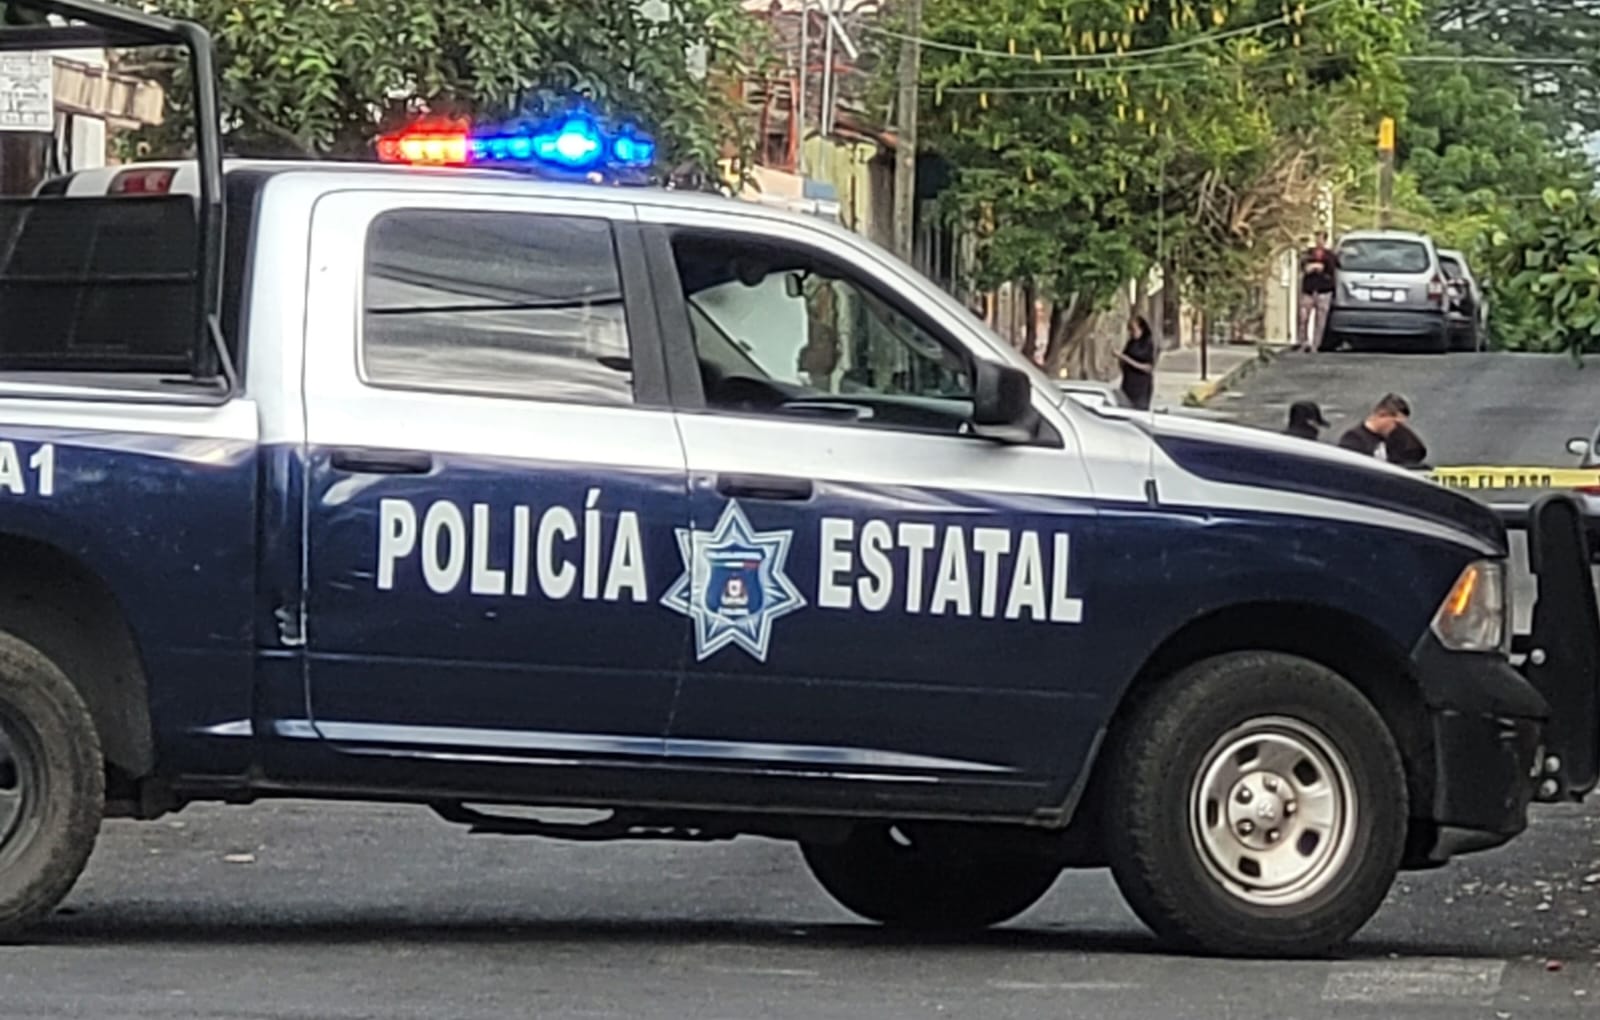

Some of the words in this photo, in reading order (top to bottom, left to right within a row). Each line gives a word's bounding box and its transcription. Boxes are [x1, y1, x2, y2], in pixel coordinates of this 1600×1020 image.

[0, 440, 54, 496] A1
[377, 487, 648, 602] POLICÍA
[817, 517, 1083, 623] ESTATAL
